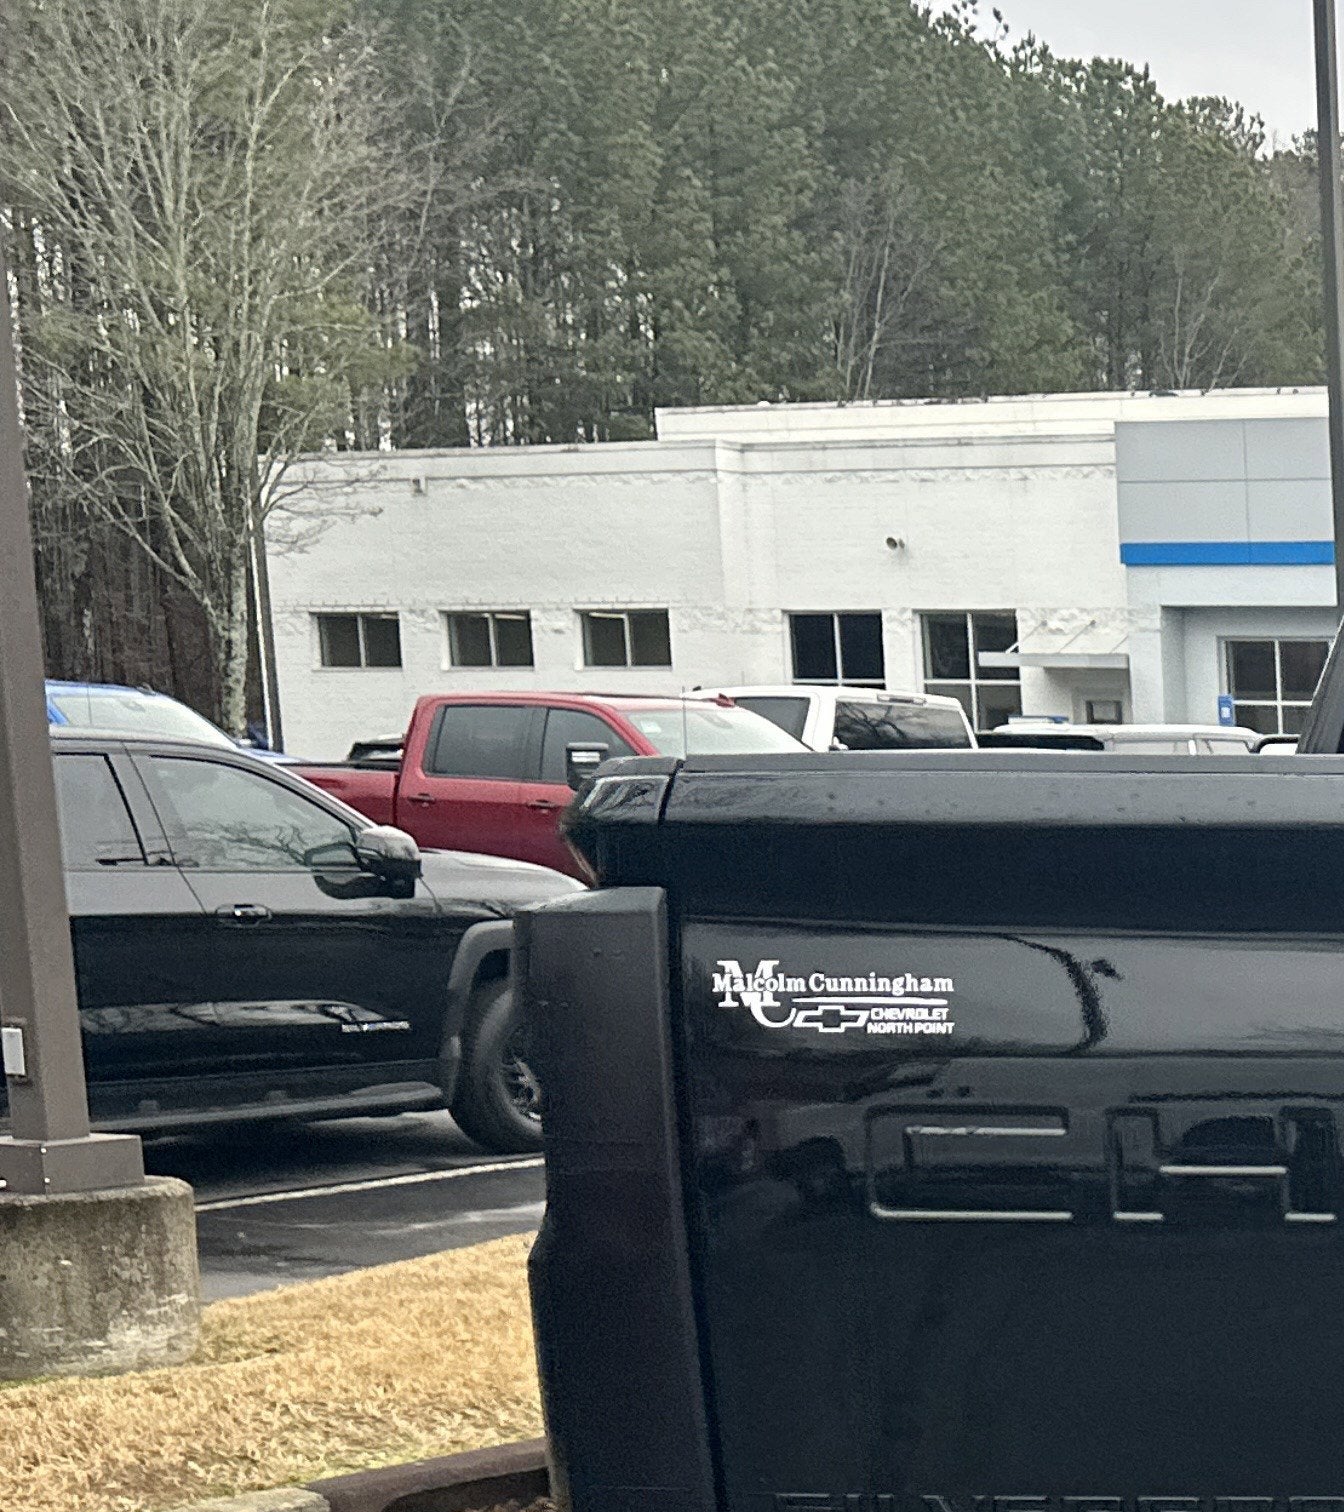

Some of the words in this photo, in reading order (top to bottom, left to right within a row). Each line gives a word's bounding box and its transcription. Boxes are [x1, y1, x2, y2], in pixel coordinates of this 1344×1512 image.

[712, 971, 806, 993] Malcolm
[808, 971, 955, 996] Cunningham
[870, 1007, 949, 1021] CHEVROLET
[867, 1022, 913, 1034] NORTH
[914, 1022, 955, 1034] POINT
